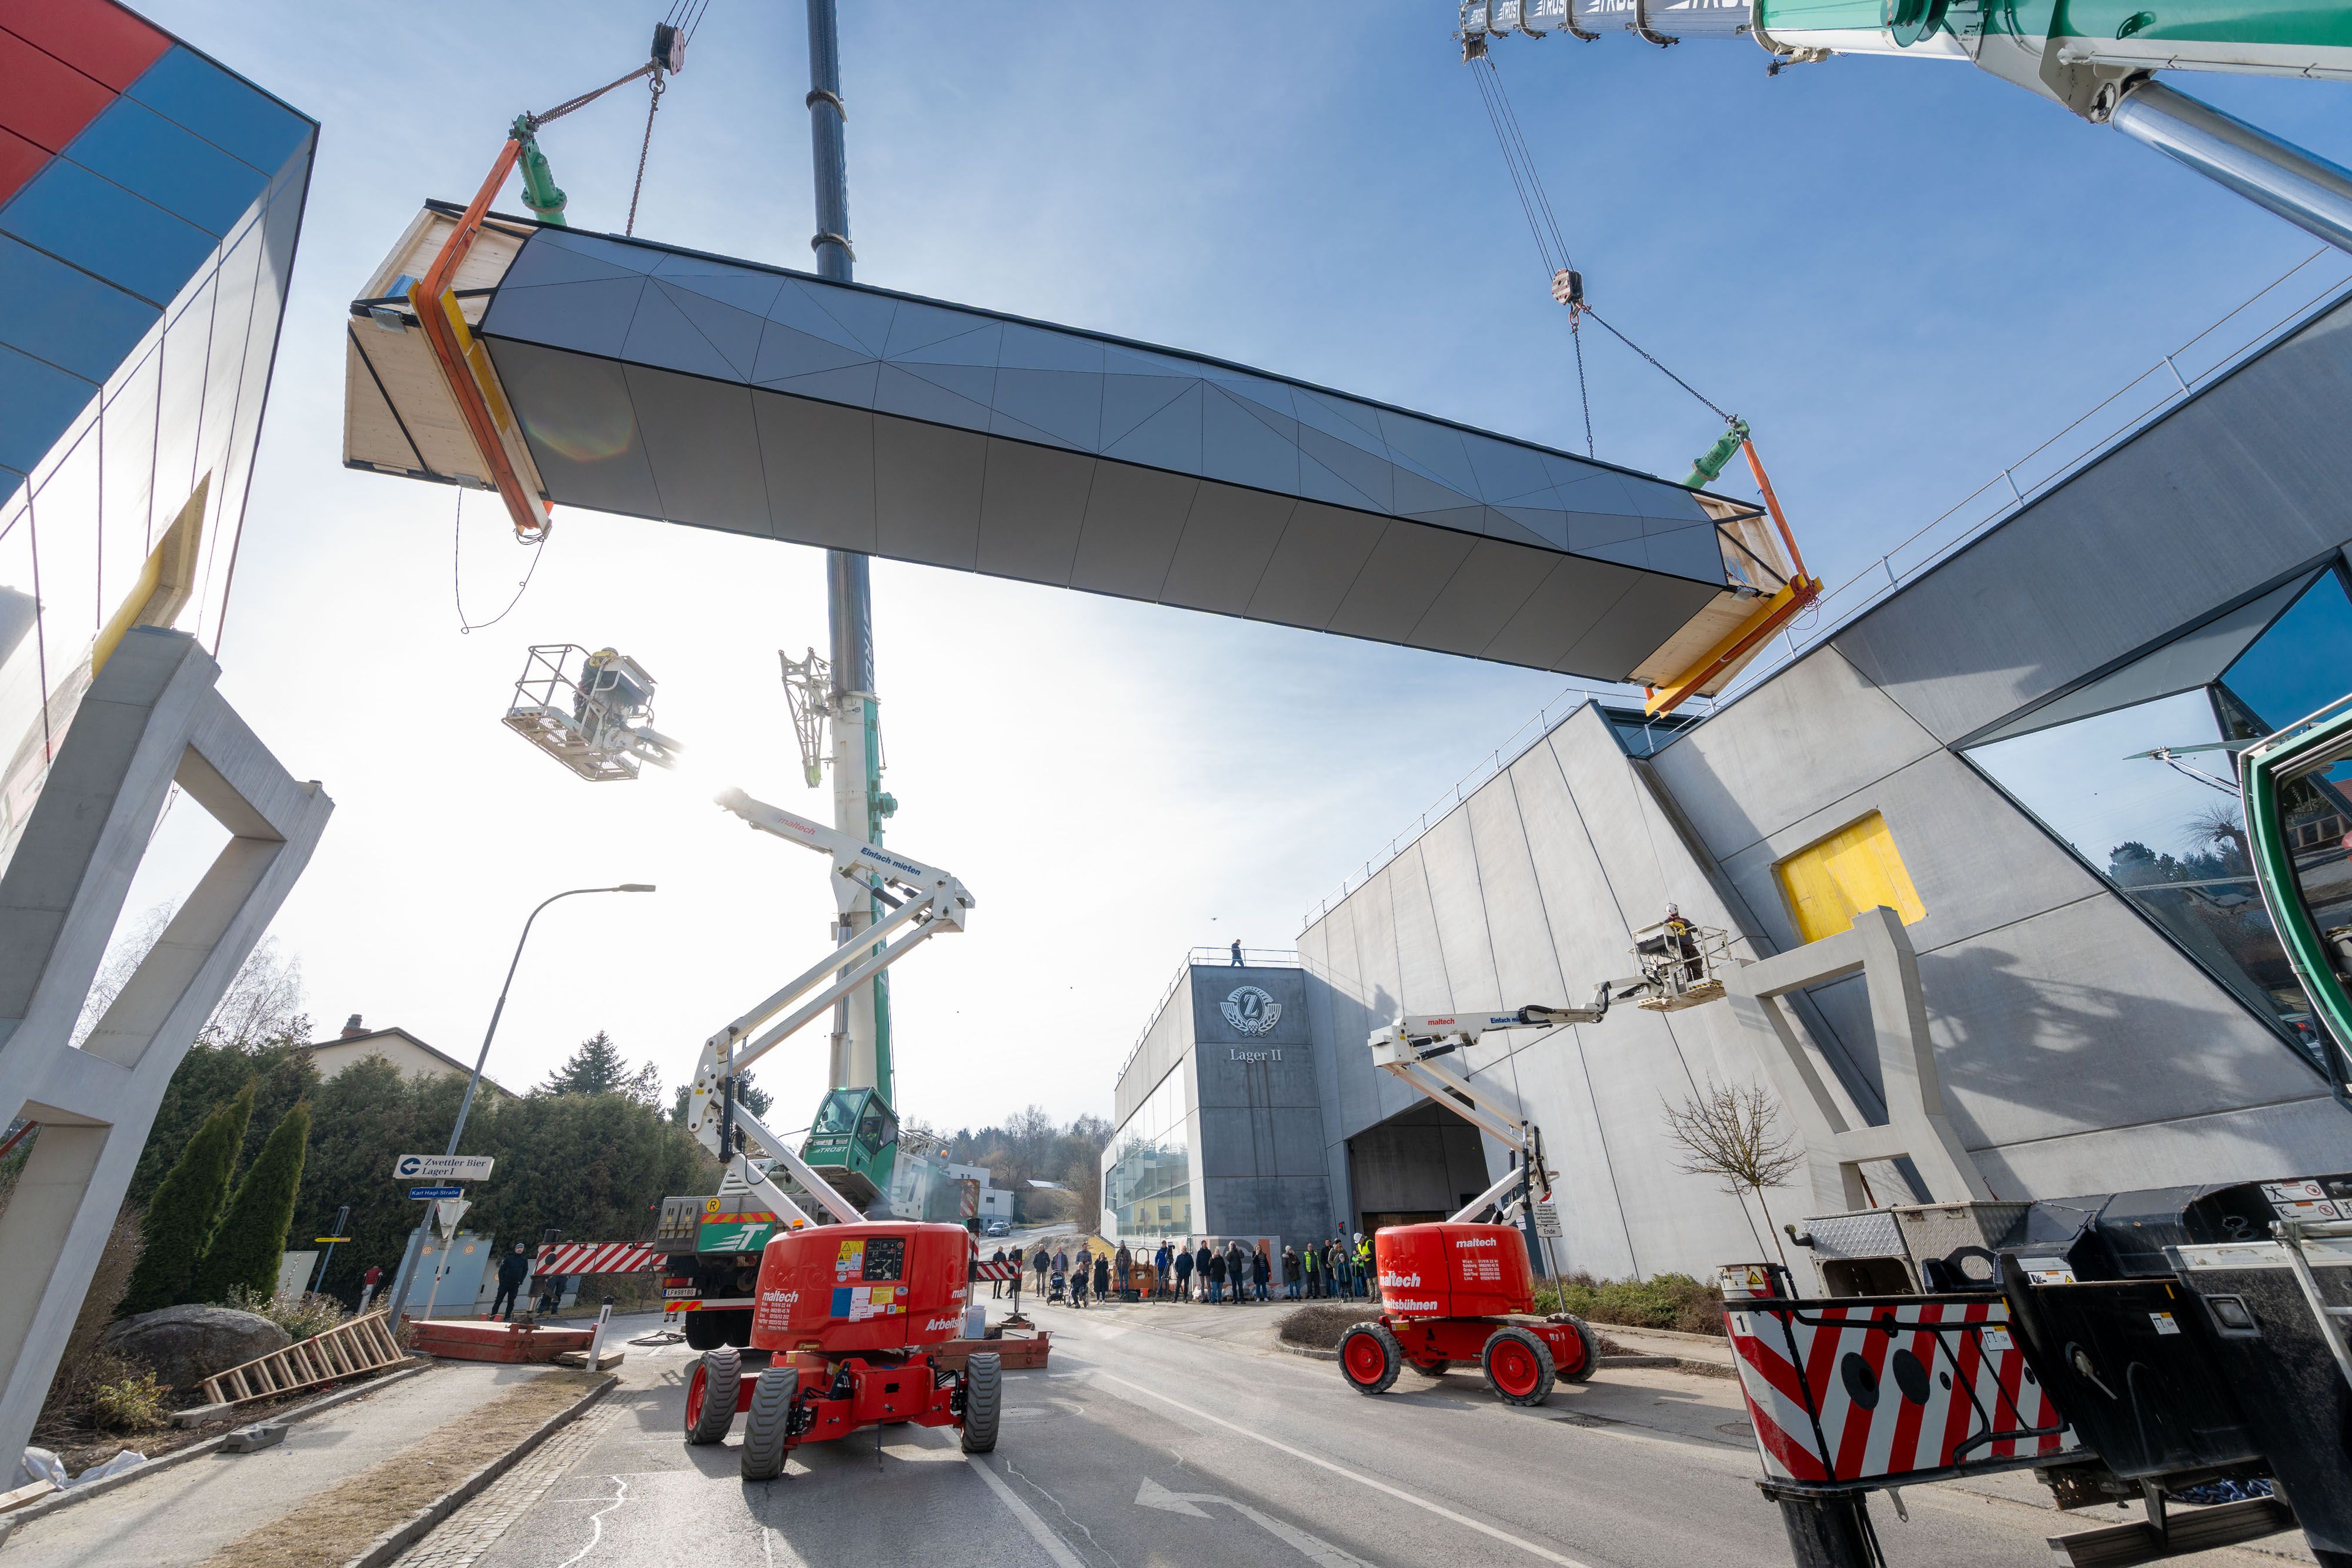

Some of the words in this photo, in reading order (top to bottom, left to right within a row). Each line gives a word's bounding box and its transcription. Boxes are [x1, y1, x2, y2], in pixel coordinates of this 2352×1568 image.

[864, 624, 873, 694] TROS
[778, 817, 816, 835] maltech
[860, 847, 891, 864] Einfach
[893, 860, 921, 876] mieten
[1244, 994, 1259, 1017] Z
[1230, 1049, 1267, 1064] Lager
[1271, 1049, 1282, 1061] II
[425, 1158, 465, 1166] Zwettler
[422, 1168, 449, 1176] Lager
[709, 1201, 717, 1210] R
[1456, 1238, 1496, 1248] maltech
[762, 1290, 799, 1303] maltech
[952, 1287, 967, 1298] malte
[1736, 1315, 1746, 1332] 1
